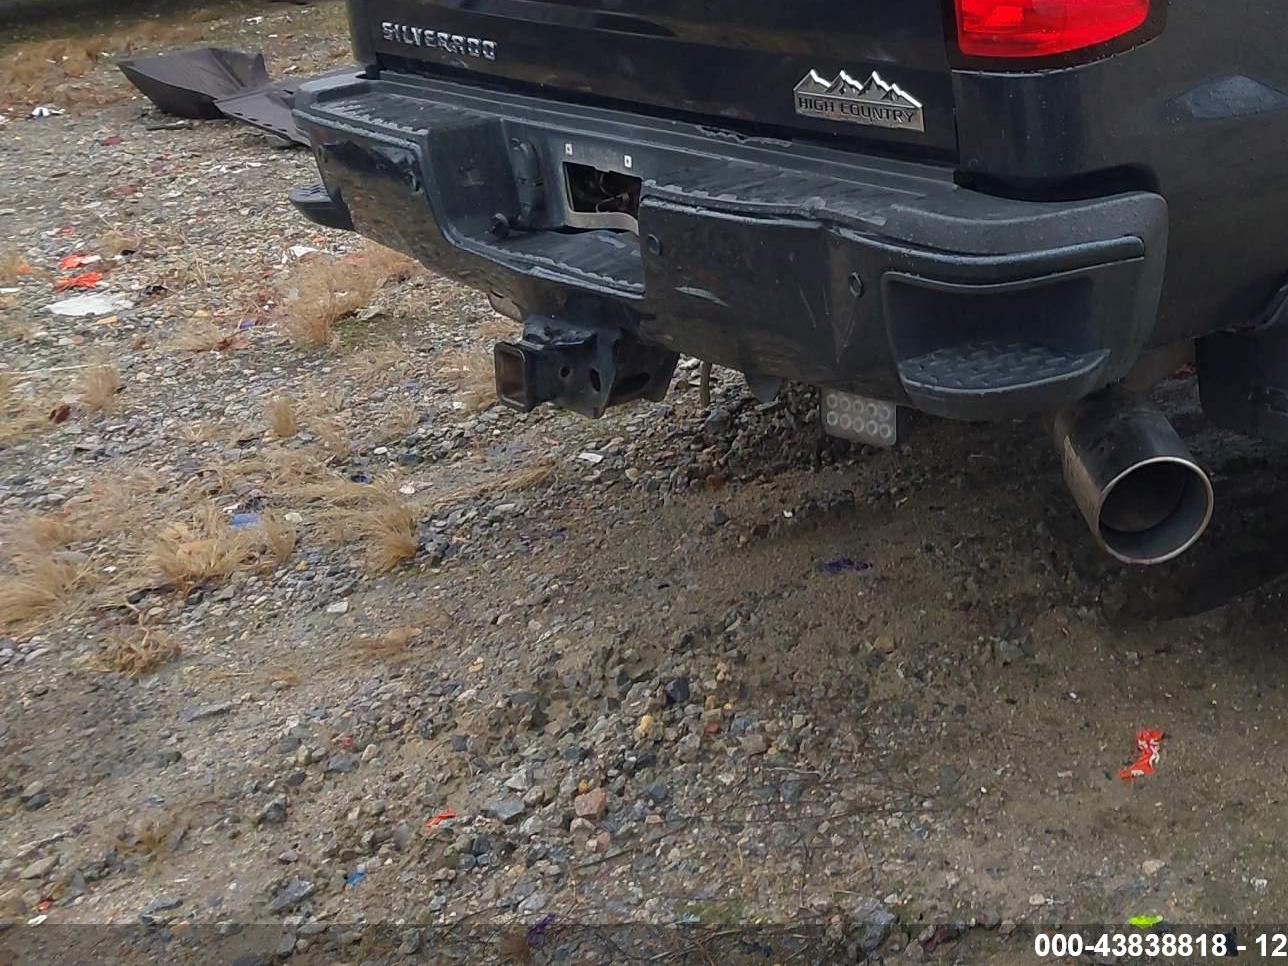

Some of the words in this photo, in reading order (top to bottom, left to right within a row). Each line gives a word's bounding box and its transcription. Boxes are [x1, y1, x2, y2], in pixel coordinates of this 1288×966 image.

[381, 21, 498, 60] SILVERADO
[799, 97, 835, 112] HIGH
[840, 102, 915, 123] COUNTRY
